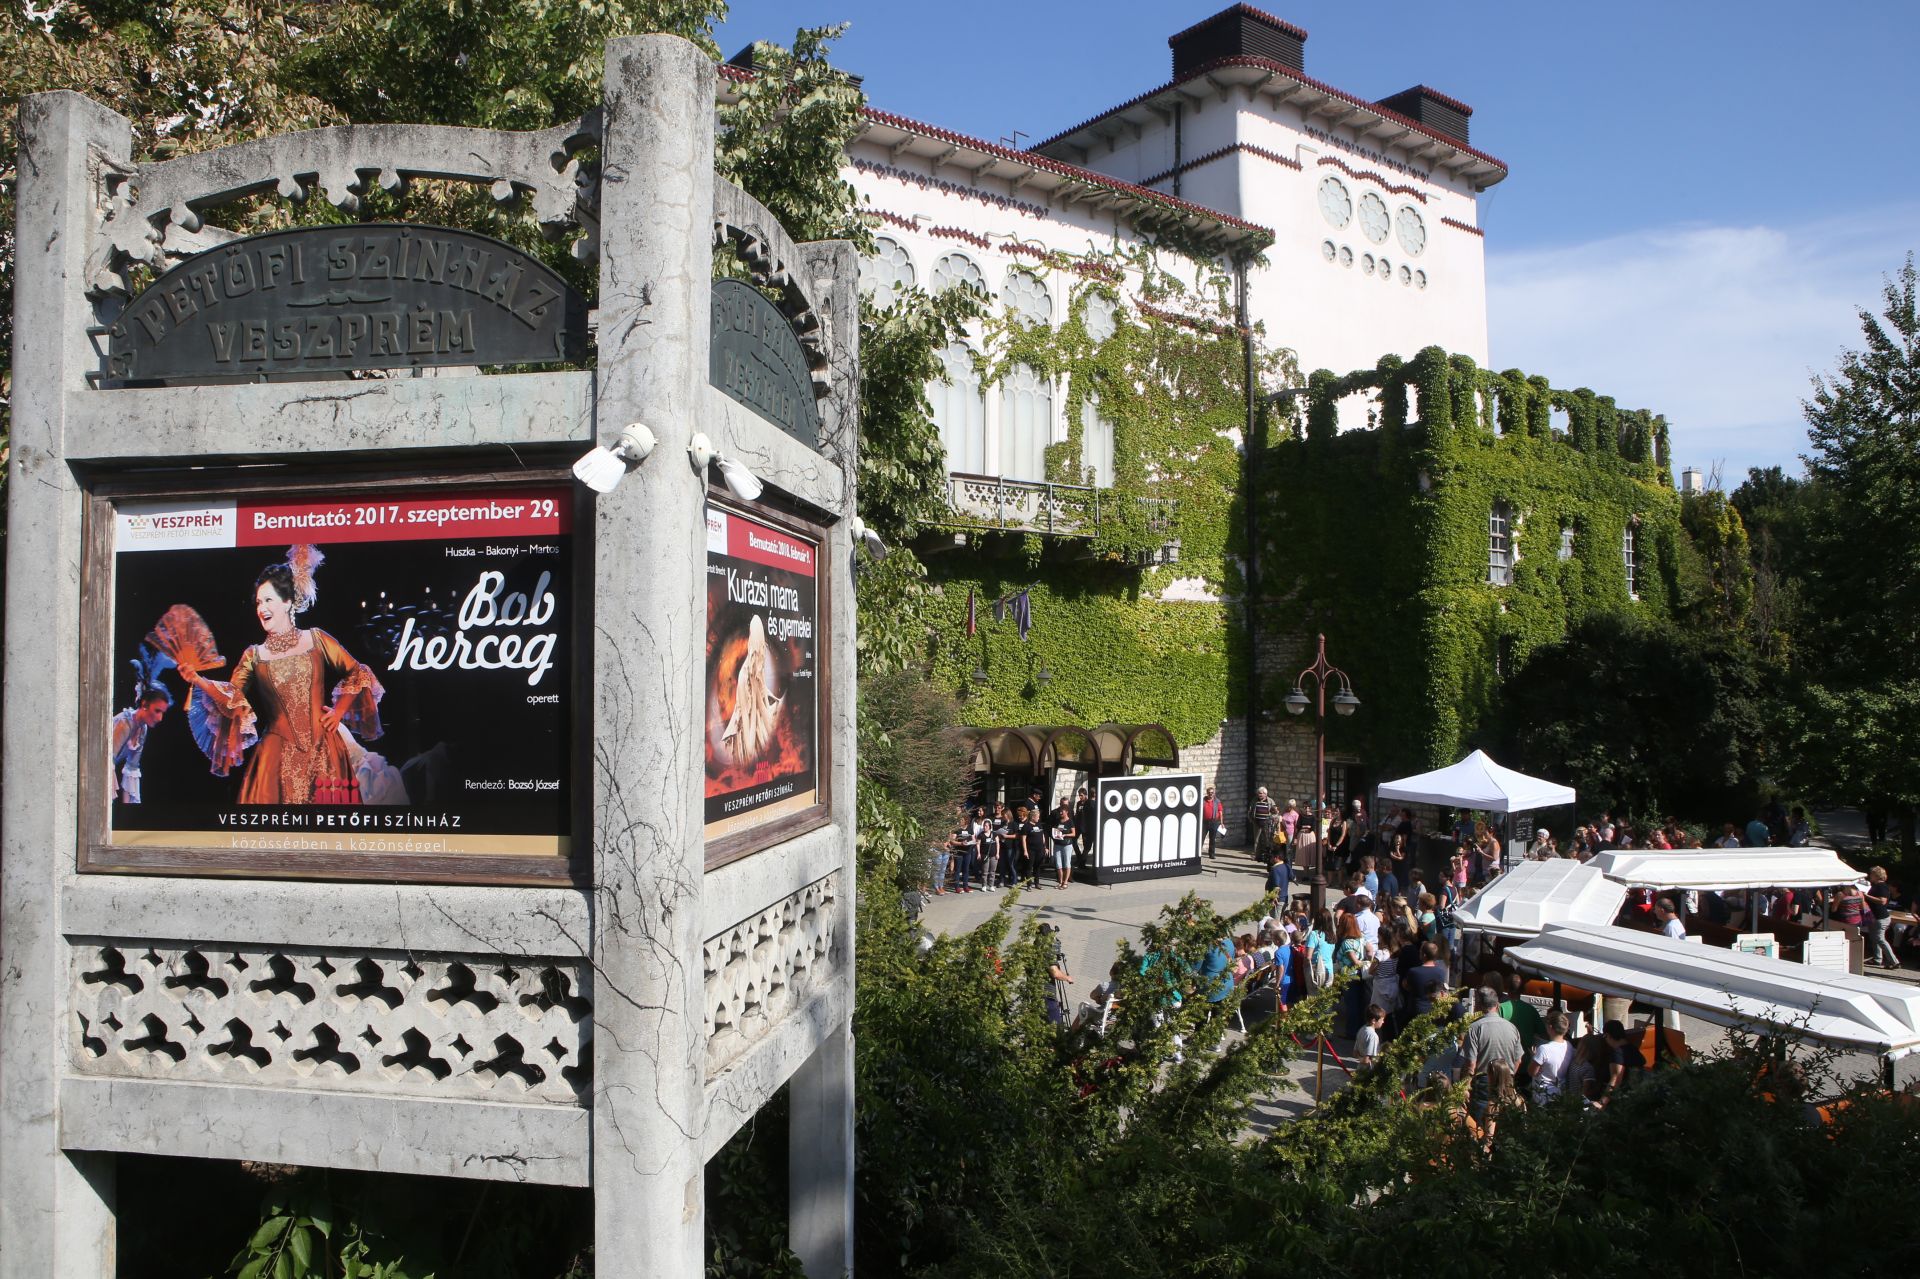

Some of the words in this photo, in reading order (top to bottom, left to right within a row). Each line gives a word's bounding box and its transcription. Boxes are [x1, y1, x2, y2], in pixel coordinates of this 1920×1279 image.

[327, 227, 561, 331] SZÍNHÁZ
[206, 302, 476, 363] VESZPRÉM
[152, 511, 223, 529] VESZPRÉM
[253, 508, 351, 529] Bemutató:
[355, 506, 404, 525] 2017.
[407, 502, 525, 526] szeptember
[530, 499, 559, 518] 29.
[445, 547, 476, 557] Huszka
[486, 545, 519, 557] Bakonyi
[529, 544, 559, 555] Martos
[458, 570, 555, 631] Bob
[727, 567, 768, 607] Kurázsi
[771, 584, 798, 612] mama
[767, 610, 777, 636] és
[779, 616, 812, 641] gyermekei
[387, 617, 558, 686] herceg
[526, 694, 559, 706] operett
[465, 779, 506, 790] Rendező:
[508, 779, 534, 790] Bozsó
[534, 779, 560, 792] József
[724, 794, 754, 812] VESZPRÉMI
[755, 788, 773, 803] PETŐFI
[774, 782, 793, 798] SZÍNHÁZ
[218, 811, 309, 826] VESZPRÉMI
[316, 812, 379, 827] PETŐFI
[384, 812, 462, 828] SZÍNHÁZ
[335, 841, 343, 851] a
[1113, 864, 1141, 873] VESZPRÉMI
[1142, 862, 1163, 871] PETŐFI
[1164, 860, 1187, 868] SZÍNHÁZ
